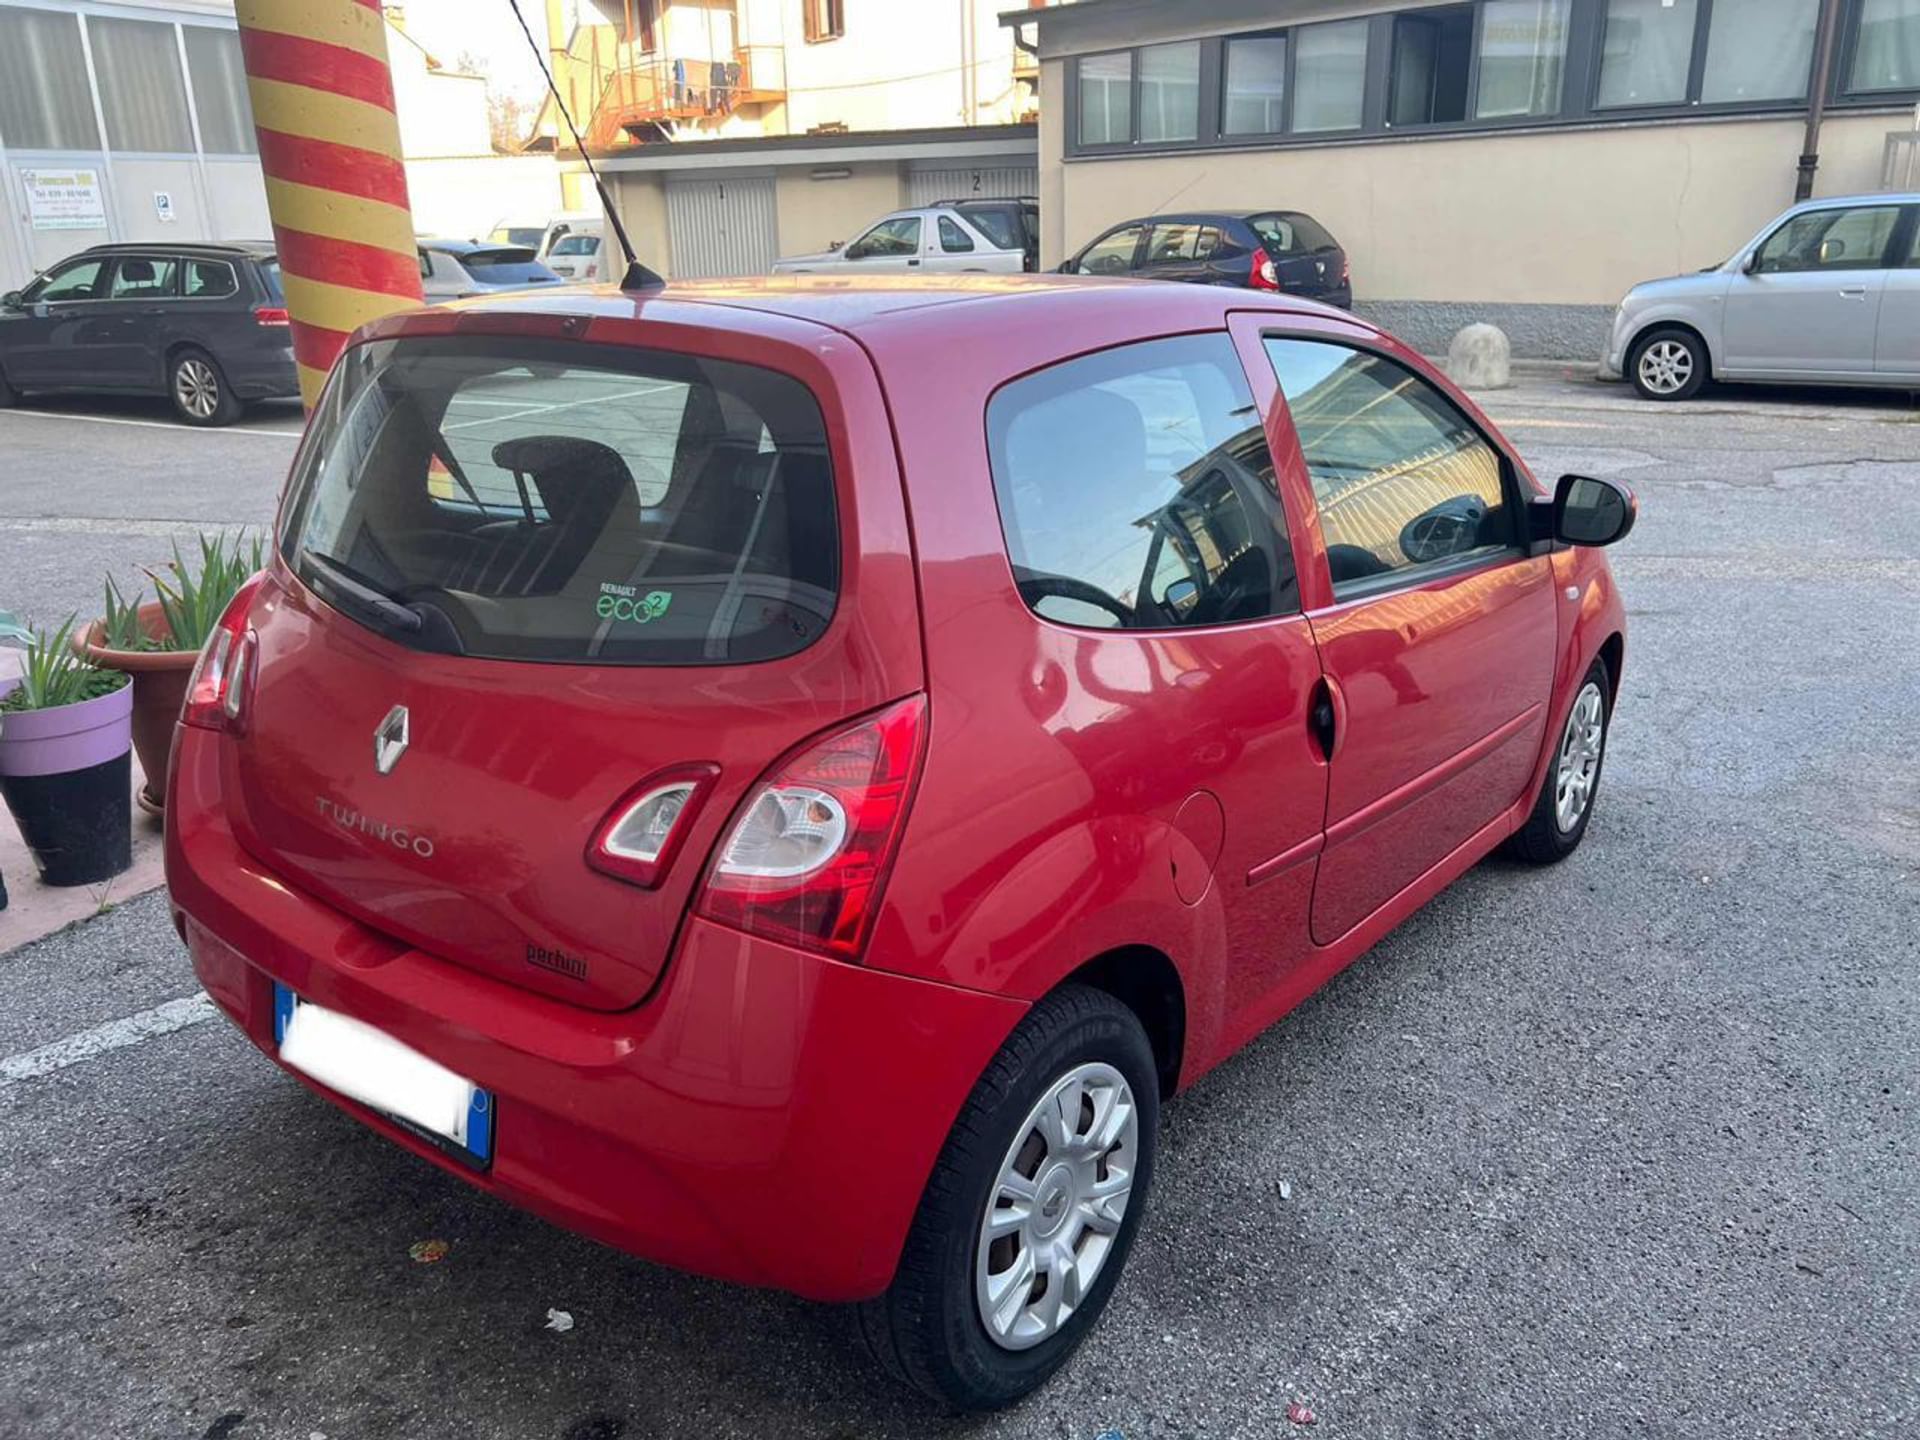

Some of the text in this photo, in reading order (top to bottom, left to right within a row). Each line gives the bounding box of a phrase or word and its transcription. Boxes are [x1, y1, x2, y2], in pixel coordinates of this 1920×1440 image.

[972, 175, 981, 191] 2
[600, 582, 637, 597] RENAULT
[316, 796, 434, 857] TWINGO
